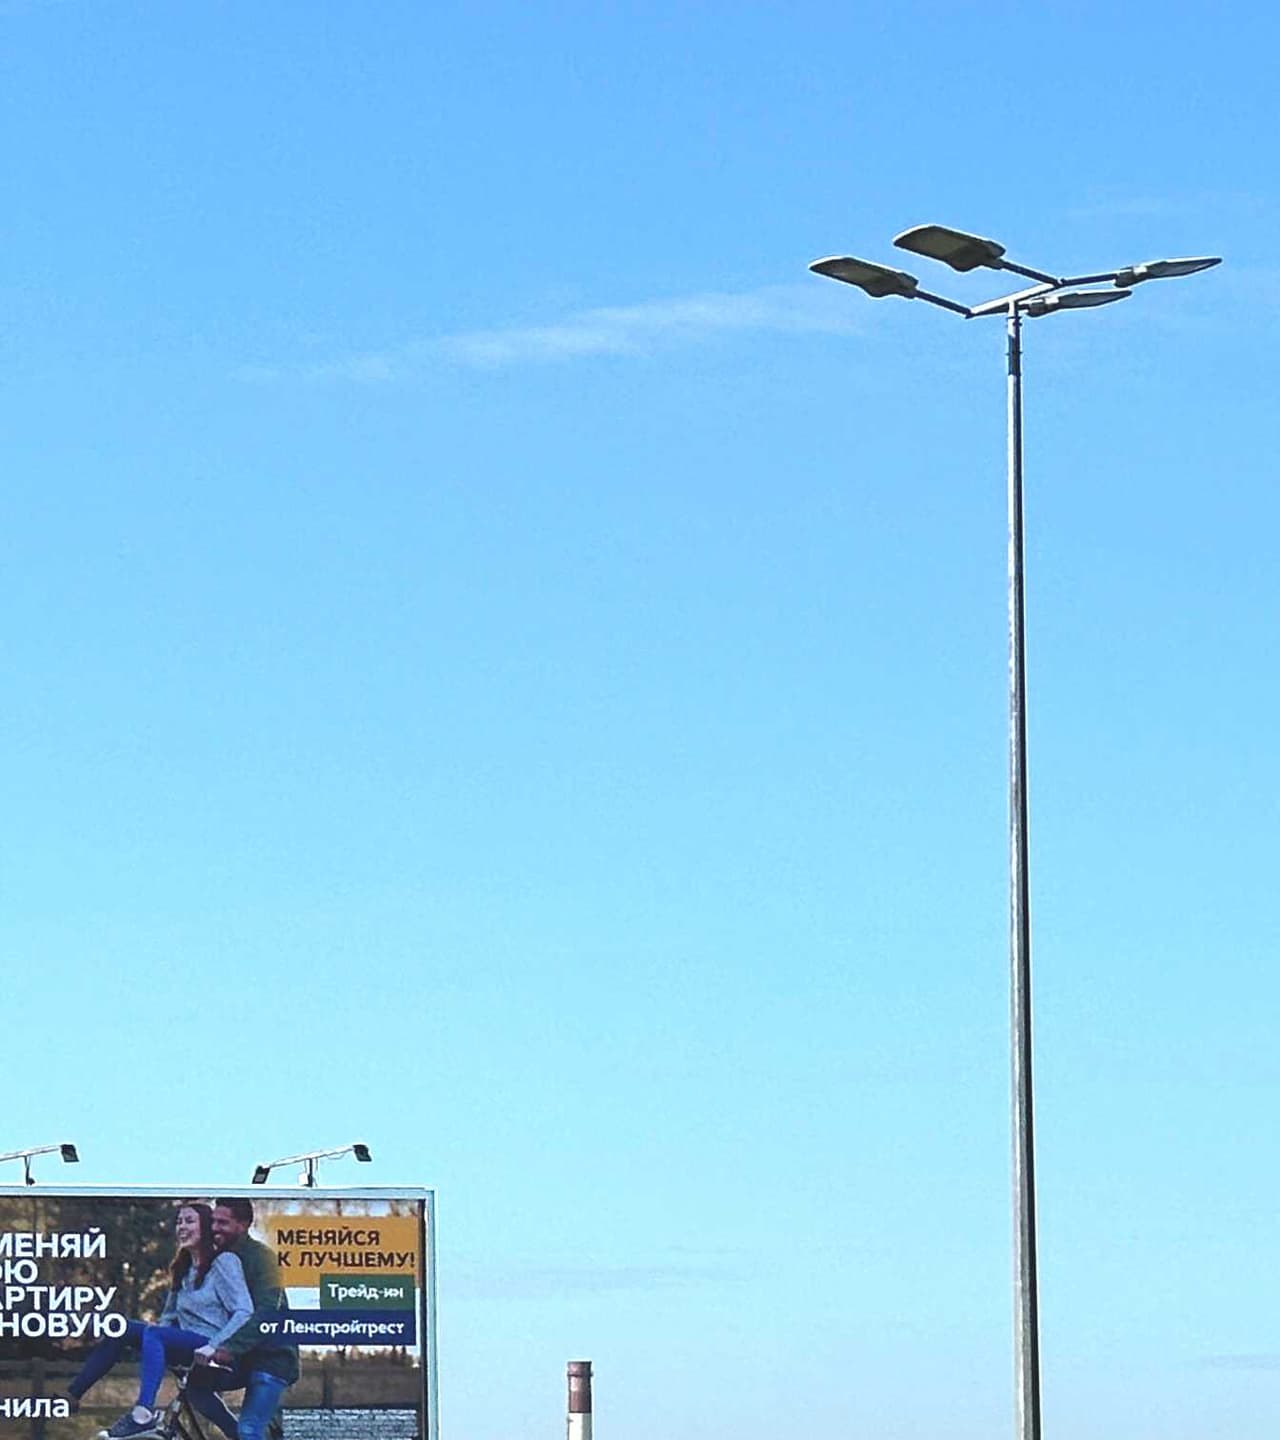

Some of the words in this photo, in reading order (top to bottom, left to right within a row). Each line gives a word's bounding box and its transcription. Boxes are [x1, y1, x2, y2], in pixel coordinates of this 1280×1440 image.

[277, 1226, 380, 1246] МЕНЯЙСЯ
[278, 1252, 291, 1267] К
[299, 1252, 415, 1267] ЛУЧШЕМУ!
[327, 1284, 404, 1301] Трейд-ин
[259, 1322, 278, 1334] от
[283, 1319, 405, 1337] Ленстройтрест
